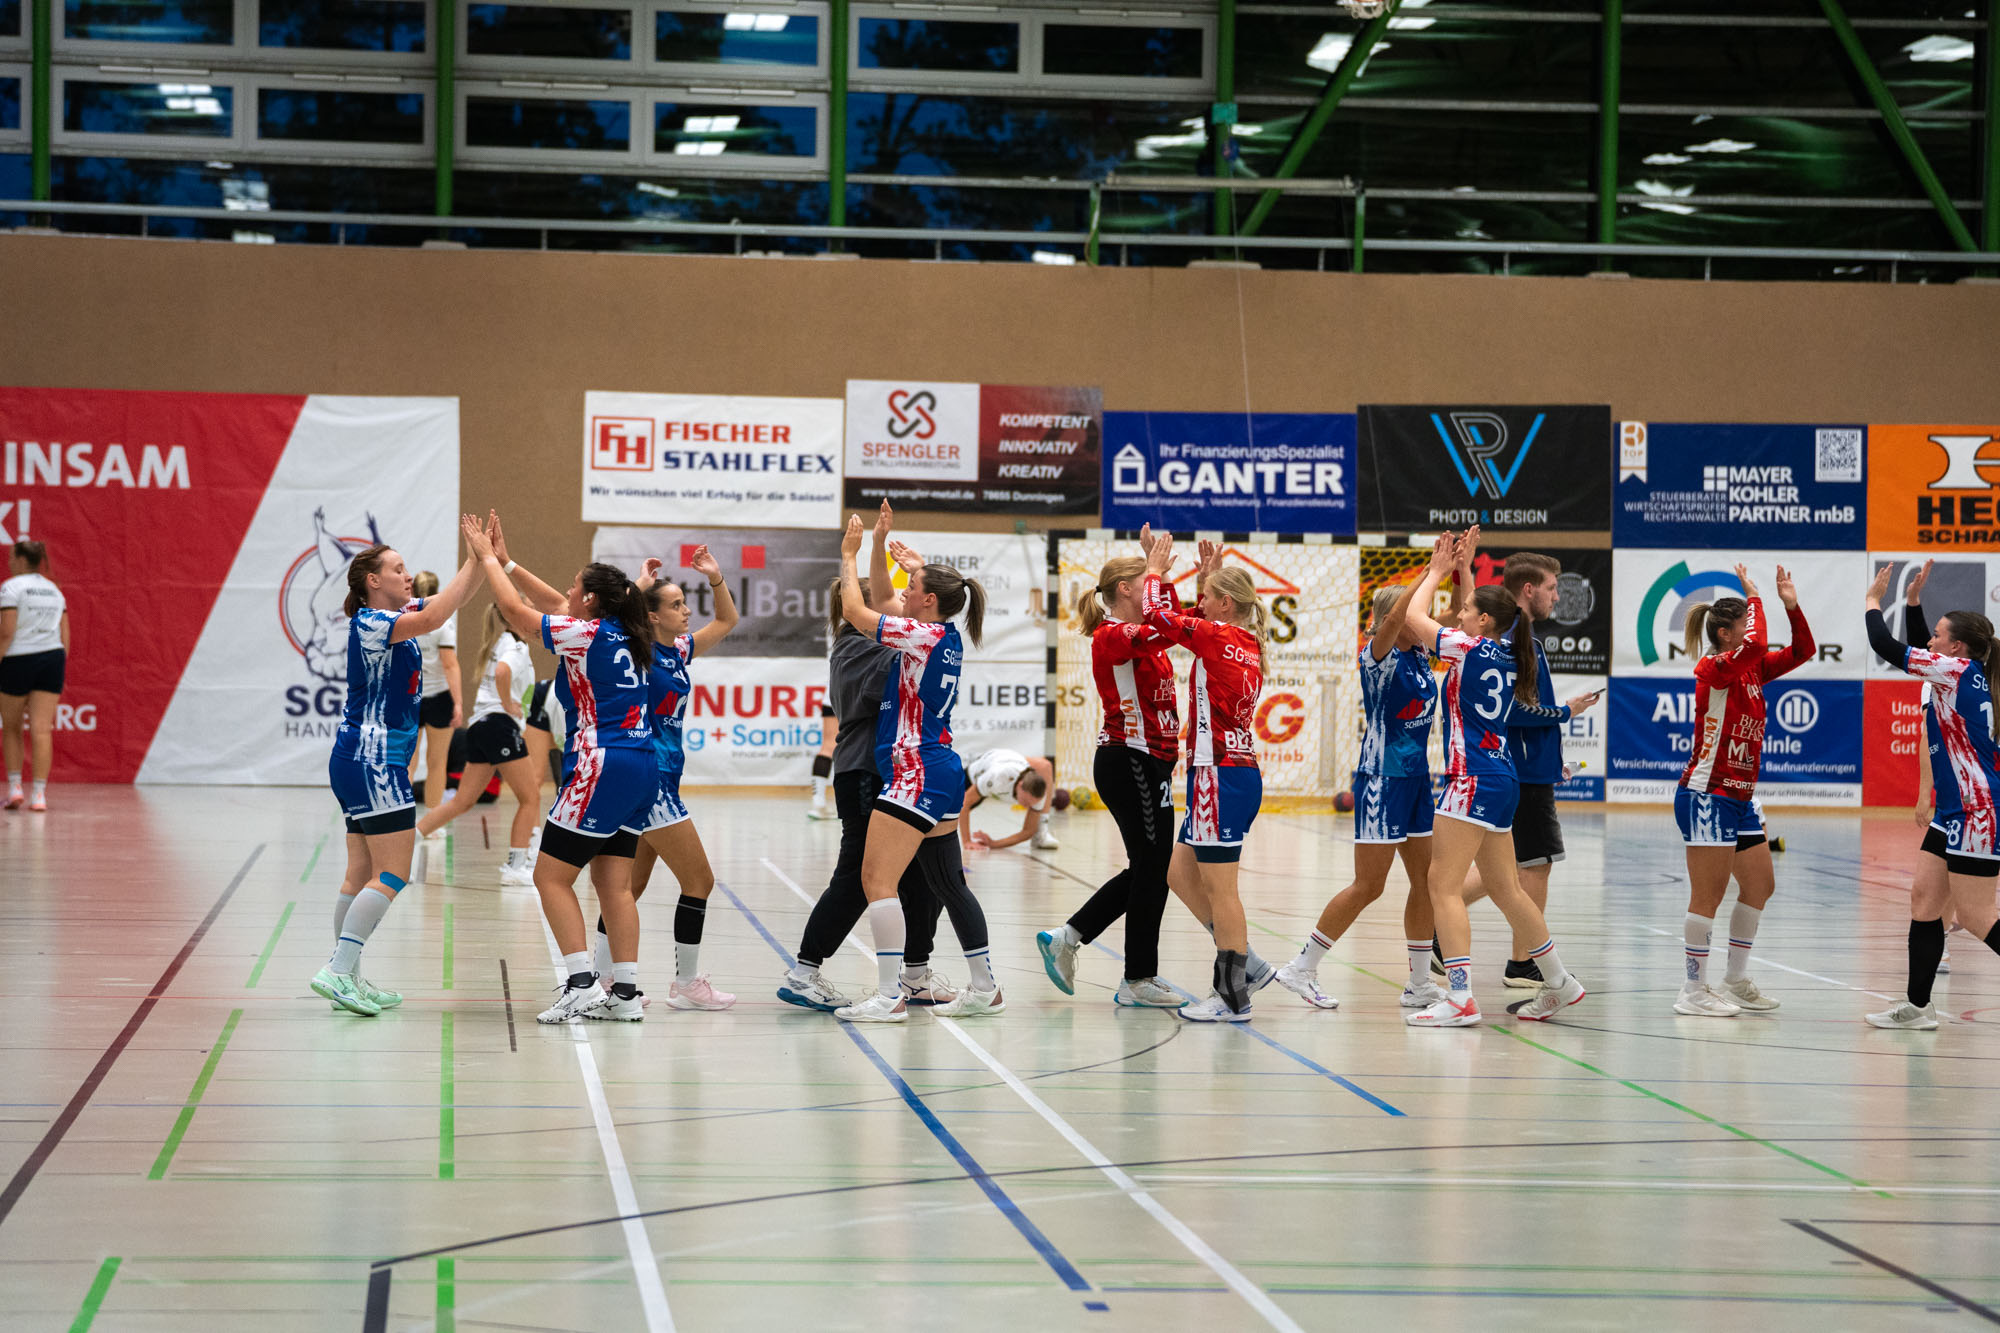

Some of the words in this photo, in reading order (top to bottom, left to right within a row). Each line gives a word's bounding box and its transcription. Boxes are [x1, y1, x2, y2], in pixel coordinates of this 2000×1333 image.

[999, 413, 1092, 429] KOMPETENT
[664, 421, 792, 444] FISCHER
[862, 442, 961, 460] SPENGLER
[998, 440, 1079, 455] INNOVATIV
[1159, 444, 1179, 457] Ihr
[1182, 443, 1345, 462] FinanzierungsSpezialist
[5, 441, 192, 489] INSAM
[663, 451, 835, 474] STAHLFLEX
[997, 464, 1064, 479] KREATIV
[1729, 465, 1793, 484] MAYER
[590, 486, 610, 497] Wir
[615, 486, 677, 498] wünschen
[681, 488, 703, 499] viel
[707, 489, 743, 502] Erfolg
[746, 490, 763, 501] für
[767, 490, 786, 501] die
[861, 488, 976, 501] www.spengler-metall.de
[1649, 491, 1727, 501] STEUERBERATER
[1729, 485, 1799, 504] KOHLER
[1429, 509, 1478, 524] PHOTO
[1480, 510, 1490, 524] &
[1494, 509, 1547, 524] DESIGN
[1729, 506, 1811, 523] PARTNER
[1814, 505, 1856, 523] mbB
[1917, 496, 2000, 526] HE
[1223, 643, 1245, 662] SG
[285, 684, 342, 718] SG
[1891, 701, 1923, 717] Uns
[285, 720, 339, 738] HAN
[1891, 720, 1918, 736] Gut
[1890, 740, 1917, 755] Gut
[1765, 760, 1857, 775] Baufinanzierungen
